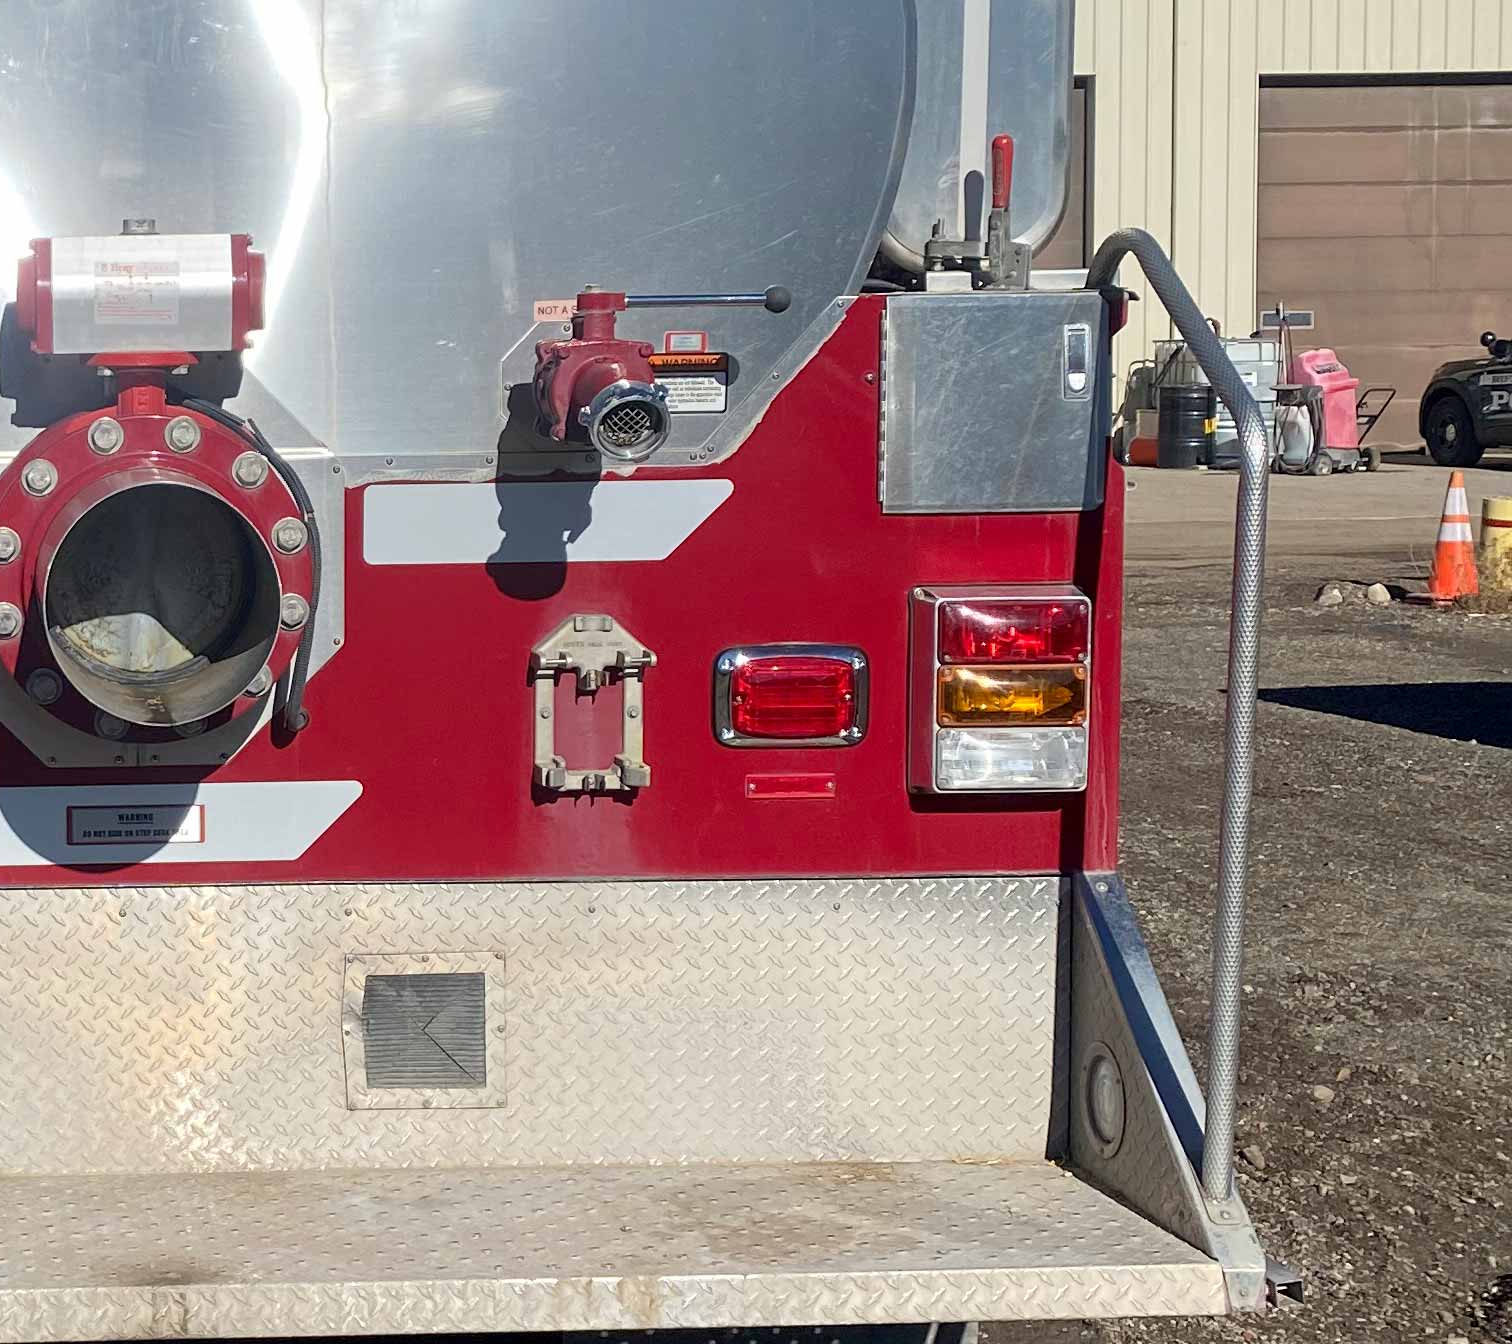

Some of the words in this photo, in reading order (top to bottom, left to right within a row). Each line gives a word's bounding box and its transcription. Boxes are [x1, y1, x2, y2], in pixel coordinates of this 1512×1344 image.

[537, 306, 559, 315] NOT
[561, 305, 569, 314] A
[662, 358, 720, 368] WARNING
[117, 813, 154, 823] WARNING
